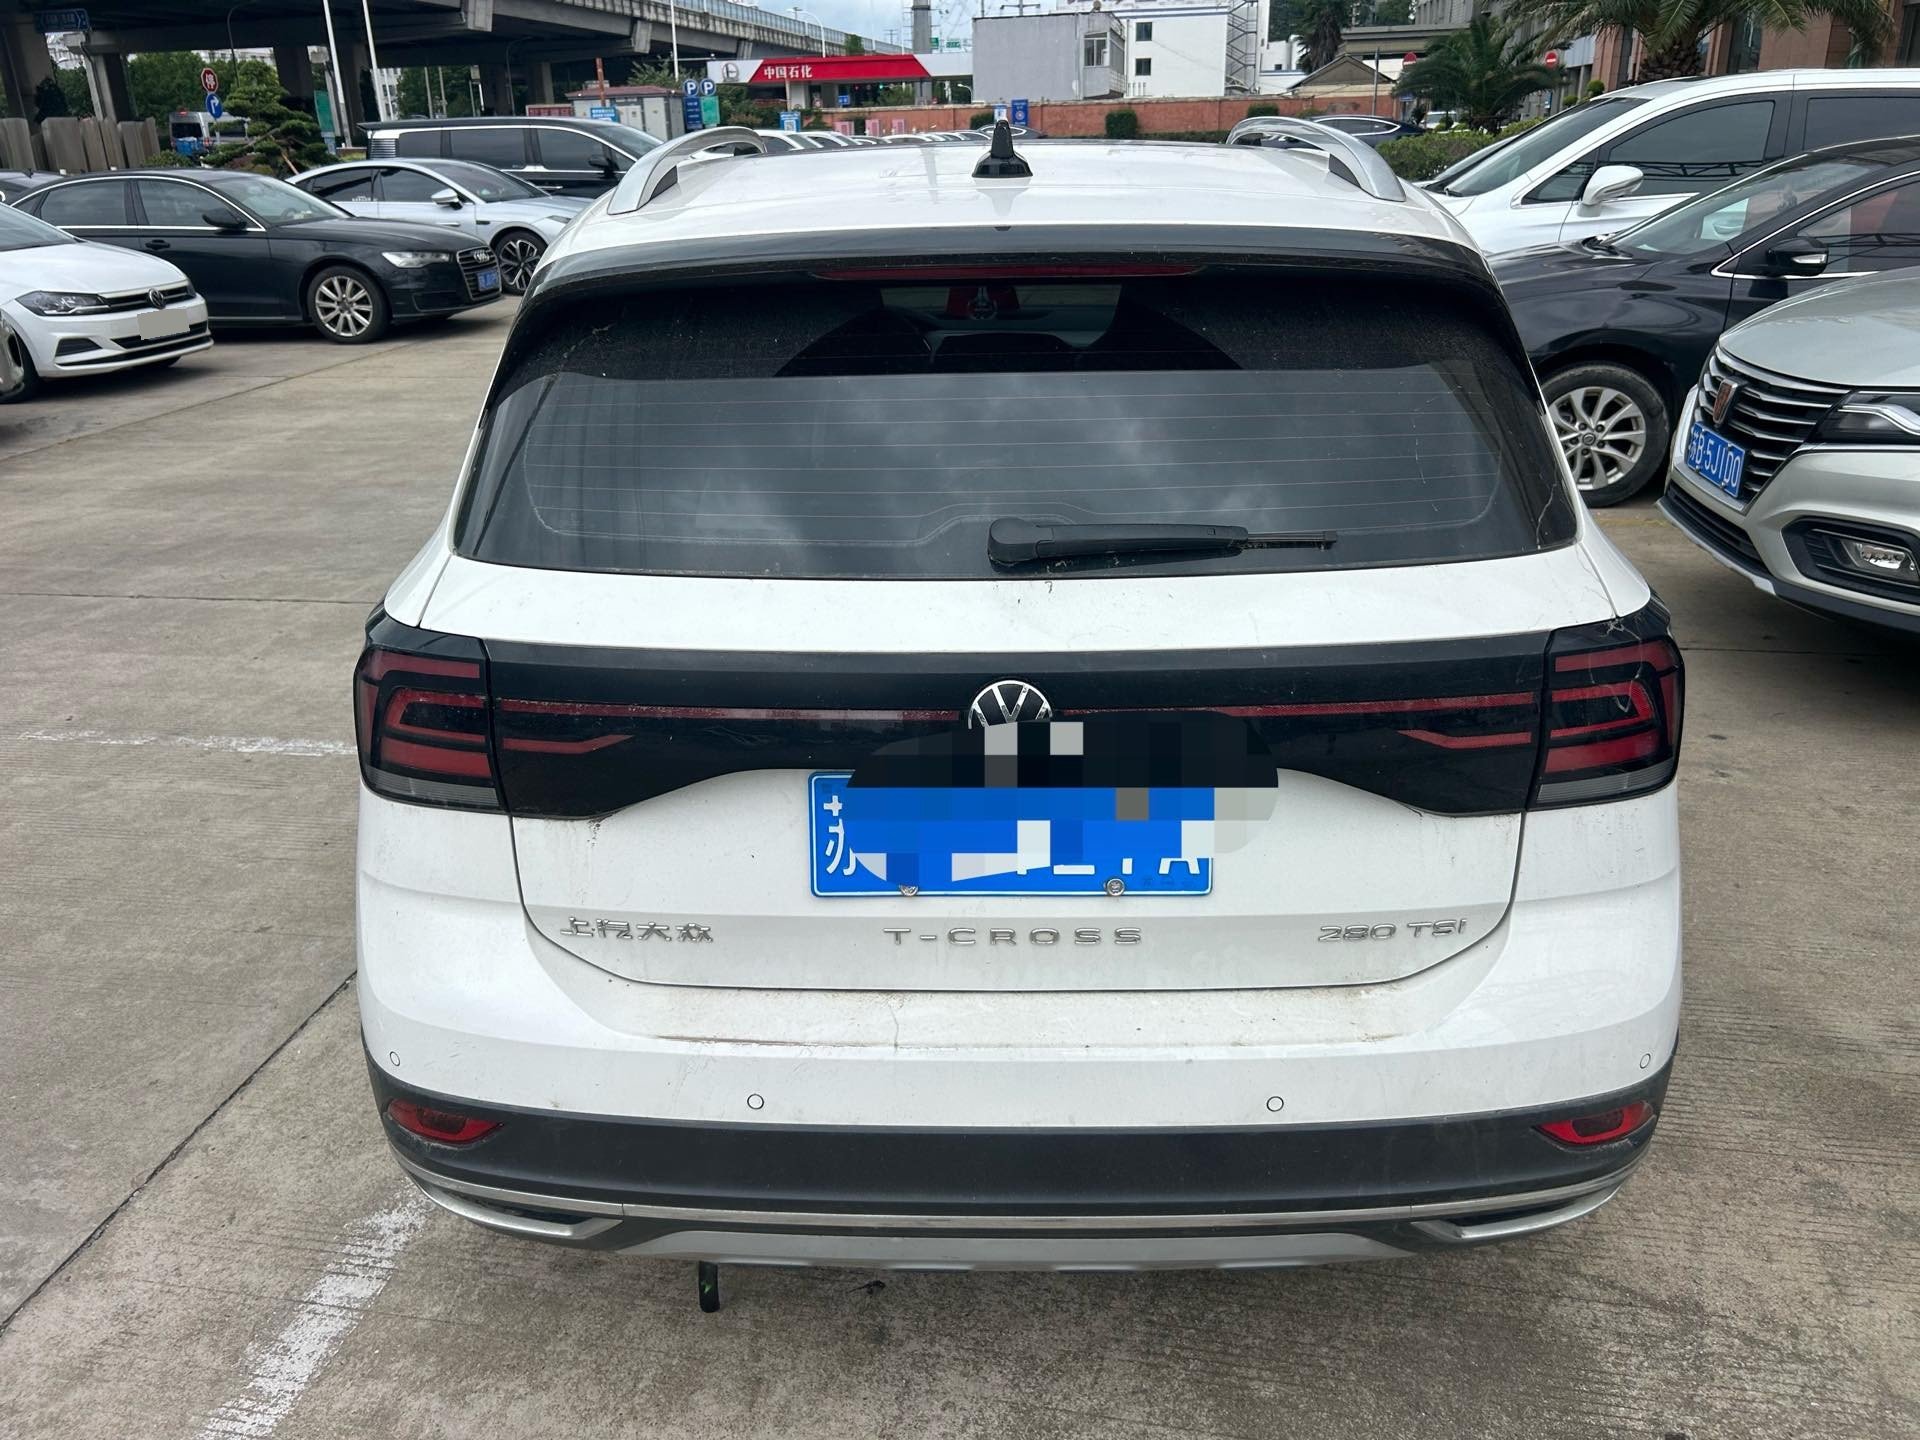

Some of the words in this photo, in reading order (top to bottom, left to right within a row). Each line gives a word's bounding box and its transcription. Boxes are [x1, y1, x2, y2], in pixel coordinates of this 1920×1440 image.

[763, 65, 813, 80] 中国石化
[686, 82, 696, 95] P
[703, 81, 714, 94] P
[560, 916, 713, 943] 上汽大众
[882, 927, 1142, 946] T-CROSS
[1318, 923, 1396, 942] 280
[1406, 917, 1468, 938] TSI
